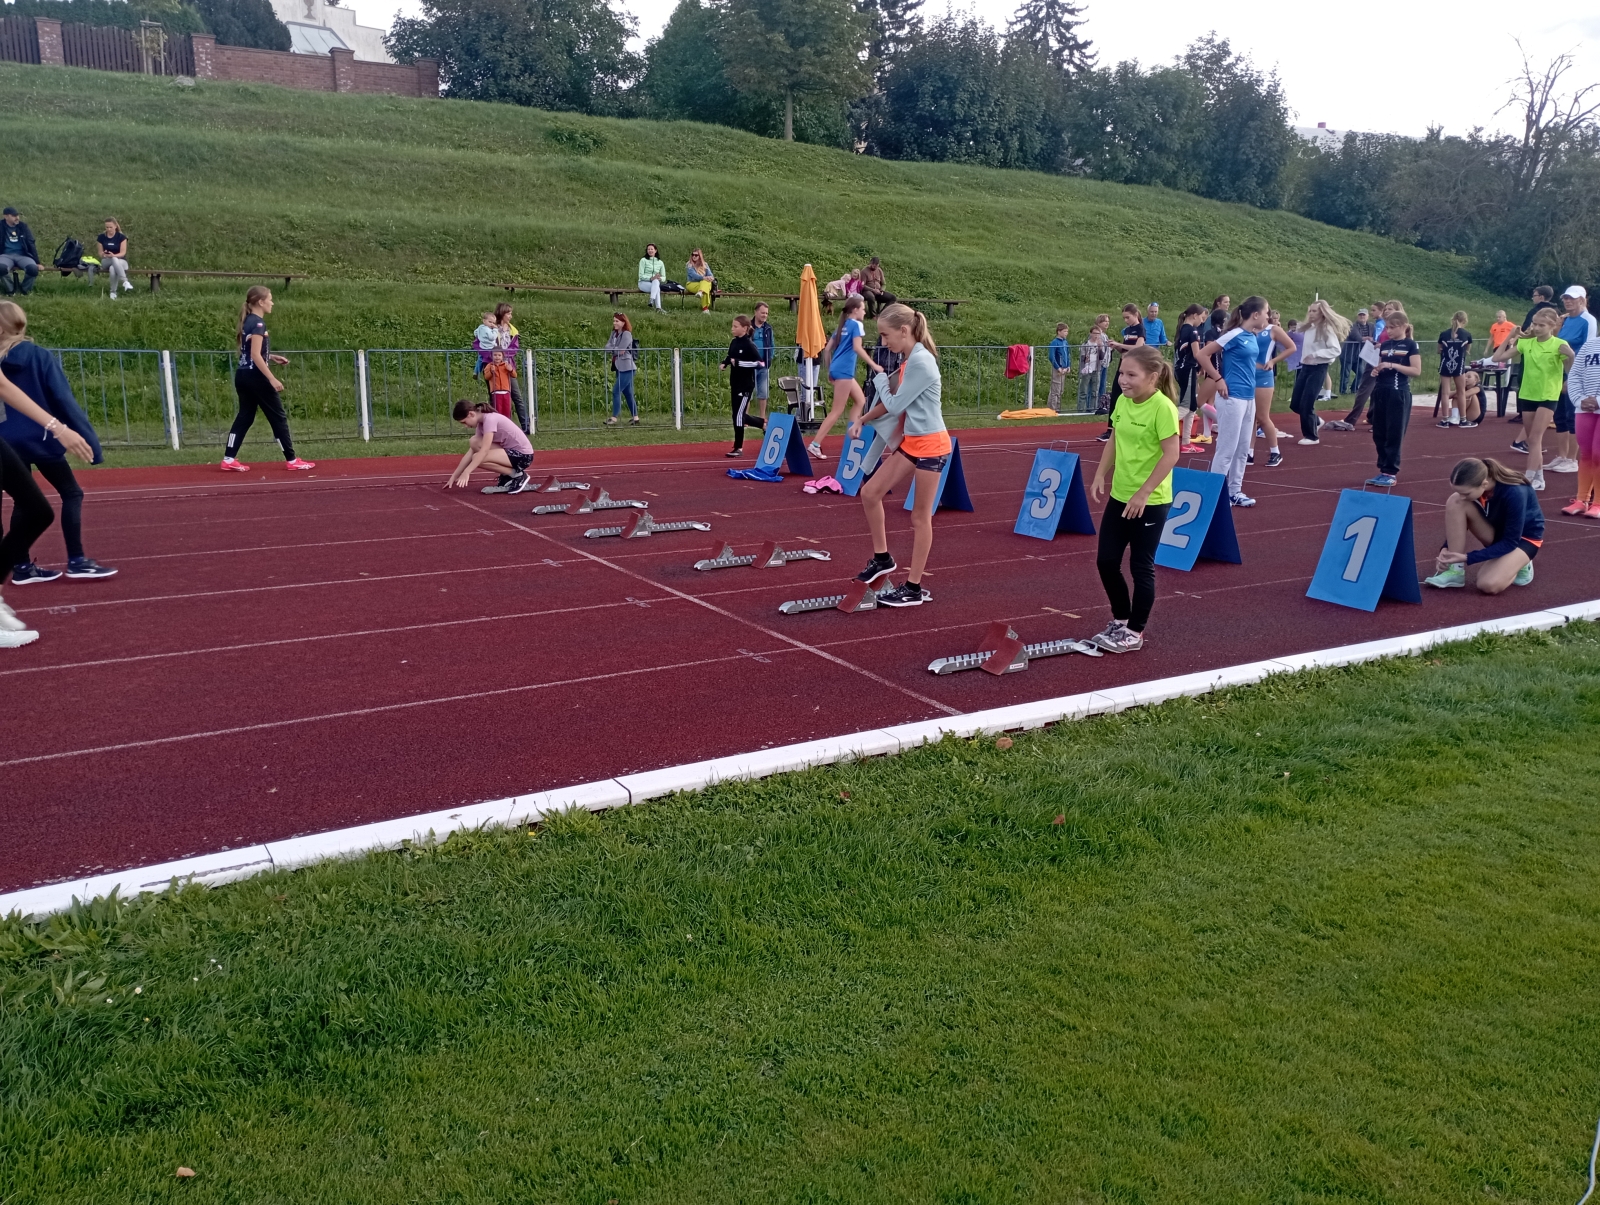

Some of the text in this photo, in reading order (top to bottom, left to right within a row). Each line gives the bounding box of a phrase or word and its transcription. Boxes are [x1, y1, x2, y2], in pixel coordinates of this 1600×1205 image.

[764, 427, 785, 465] 6
[842, 438, 866, 480] 5
[1030, 467, 1062, 520] 3
[1159, 489, 1203, 550] 2
[1341, 514, 1379, 583] 1
